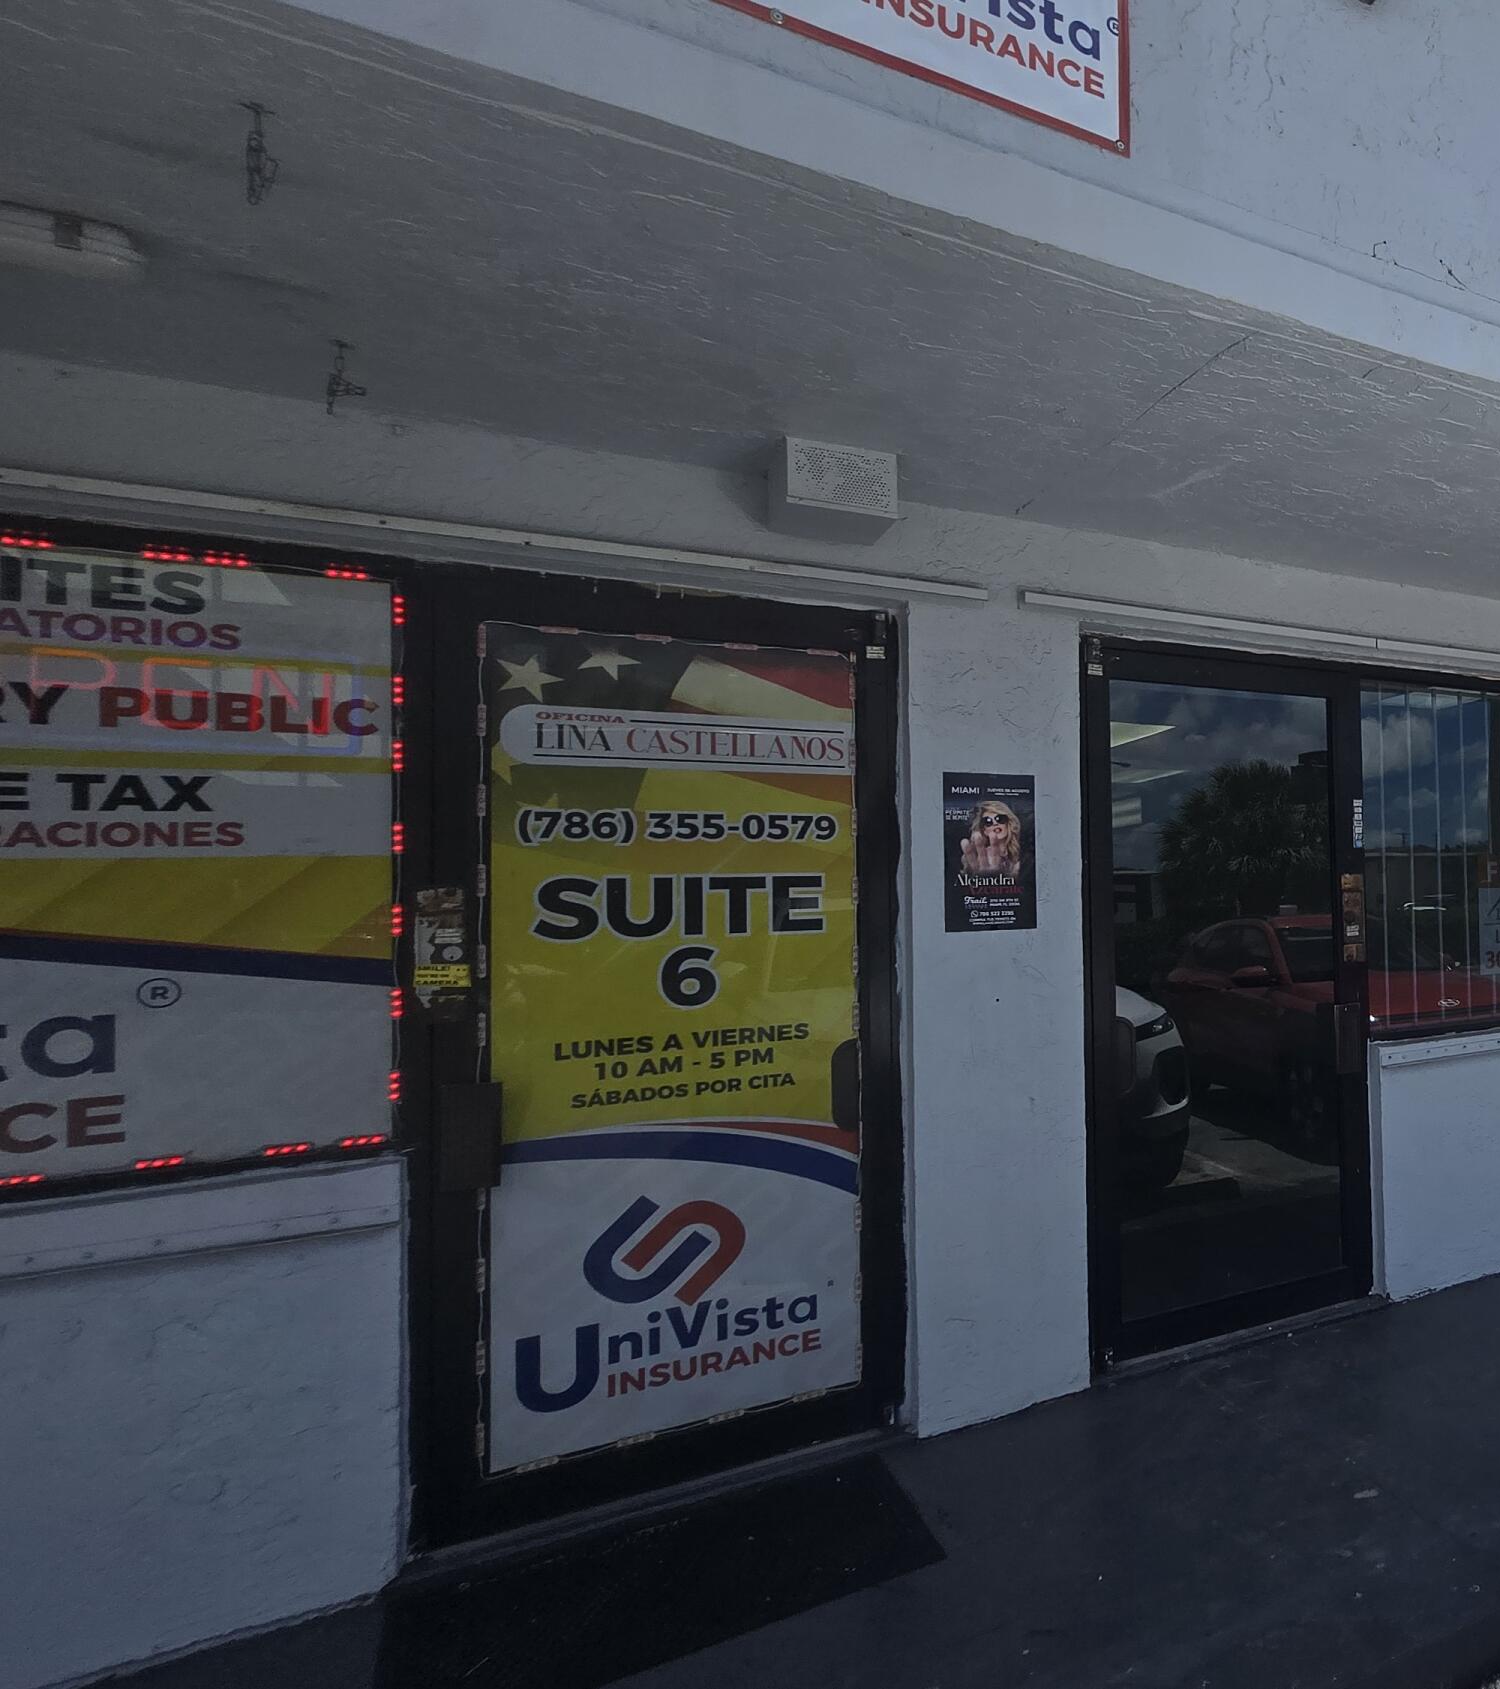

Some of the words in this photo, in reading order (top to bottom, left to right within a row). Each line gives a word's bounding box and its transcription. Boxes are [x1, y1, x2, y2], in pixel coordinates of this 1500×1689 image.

[100, 686, 381, 737] PUBLIC
[535, 711, 626, 724] OFICINA
[535, 722, 612, 753] LINA
[626, 727, 845, 762] CASTELLANOS
[56, 773, 213, 812] TAX
[951, 786, 980, 795] MIAMI
[0, 820, 245, 847] ACIONES
[519, 809, 635, 845] (786)
[647, 812, 837, 843] 355-0579
[954, 873, 1015, 888] Alejandra
[532, 875, 825, 941] SUITE
[661, 945, 718, 1009] 6
[554, 1033, 654, 1061] LUNES
[662, 1032, 683, 1051] A
[692, 1022, 810, 1050] VIERNES
[595, 1061, 629, 1081] 10
[637, 1054, 684, 1078] AM
[709, 1051, 726, 1070] 5
[734, 1047, 774, 1067] PM
[571, 1082, 688, 1109] SÁBADOS
[695, 1077, 742, 1096] POR
[748, 1072, 796, 1091] CITA
[515, 1294, 819, 1413] UniVista
[607, 1328, 822, 1398] INSURANCE
